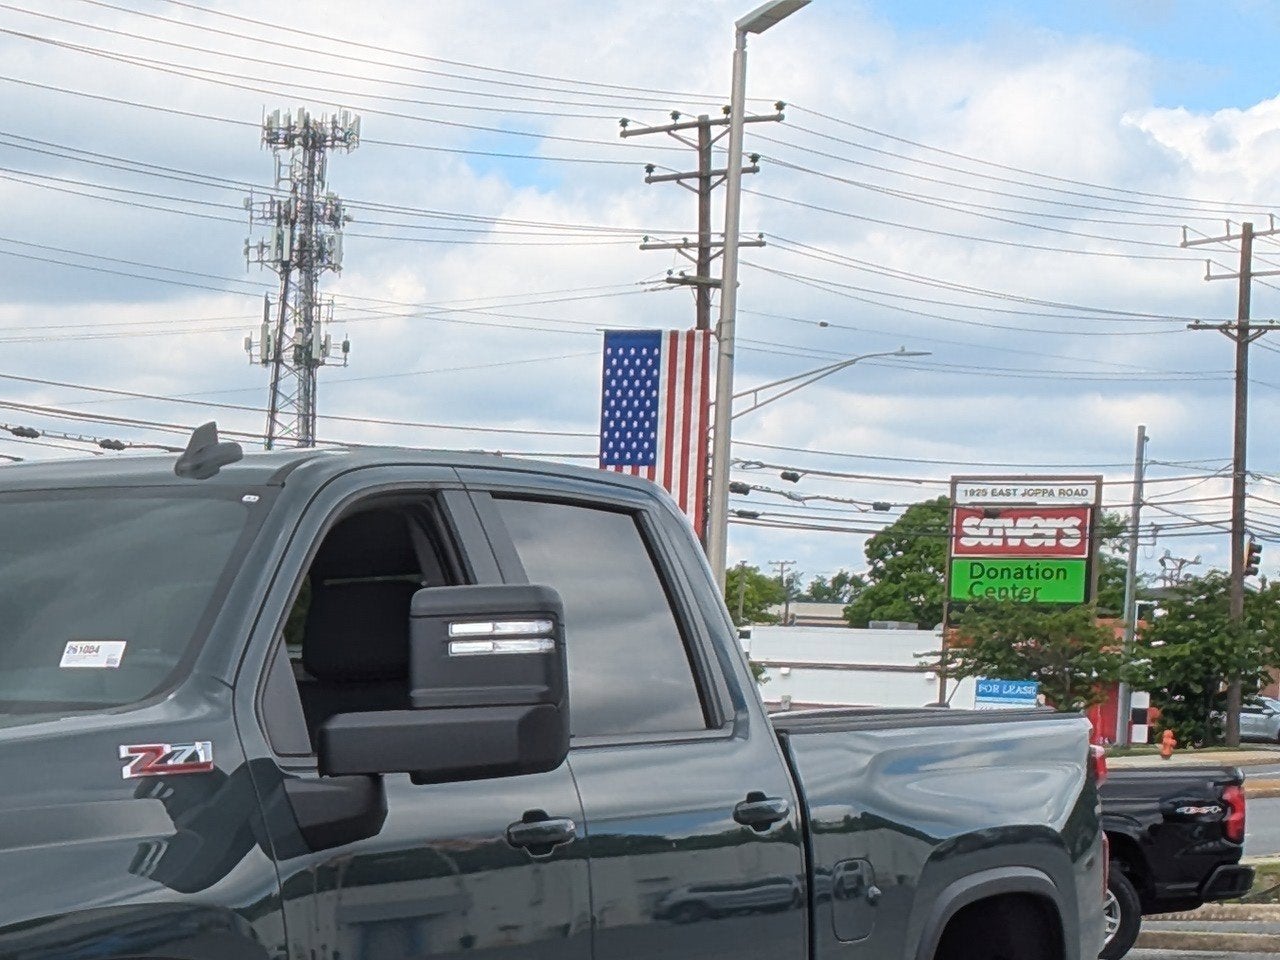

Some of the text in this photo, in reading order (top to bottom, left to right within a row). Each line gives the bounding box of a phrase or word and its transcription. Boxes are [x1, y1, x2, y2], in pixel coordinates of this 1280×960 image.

[990, 488, 1018, 498] EAST
[1021, 488, 1055, 498] JOPPA
[1058, 488, 1089, 498] ROAD
[969, 562, 1068, 581] Donation
[968, 581, 1043, 600] Center
[119, 741, 214, 779] Z71
